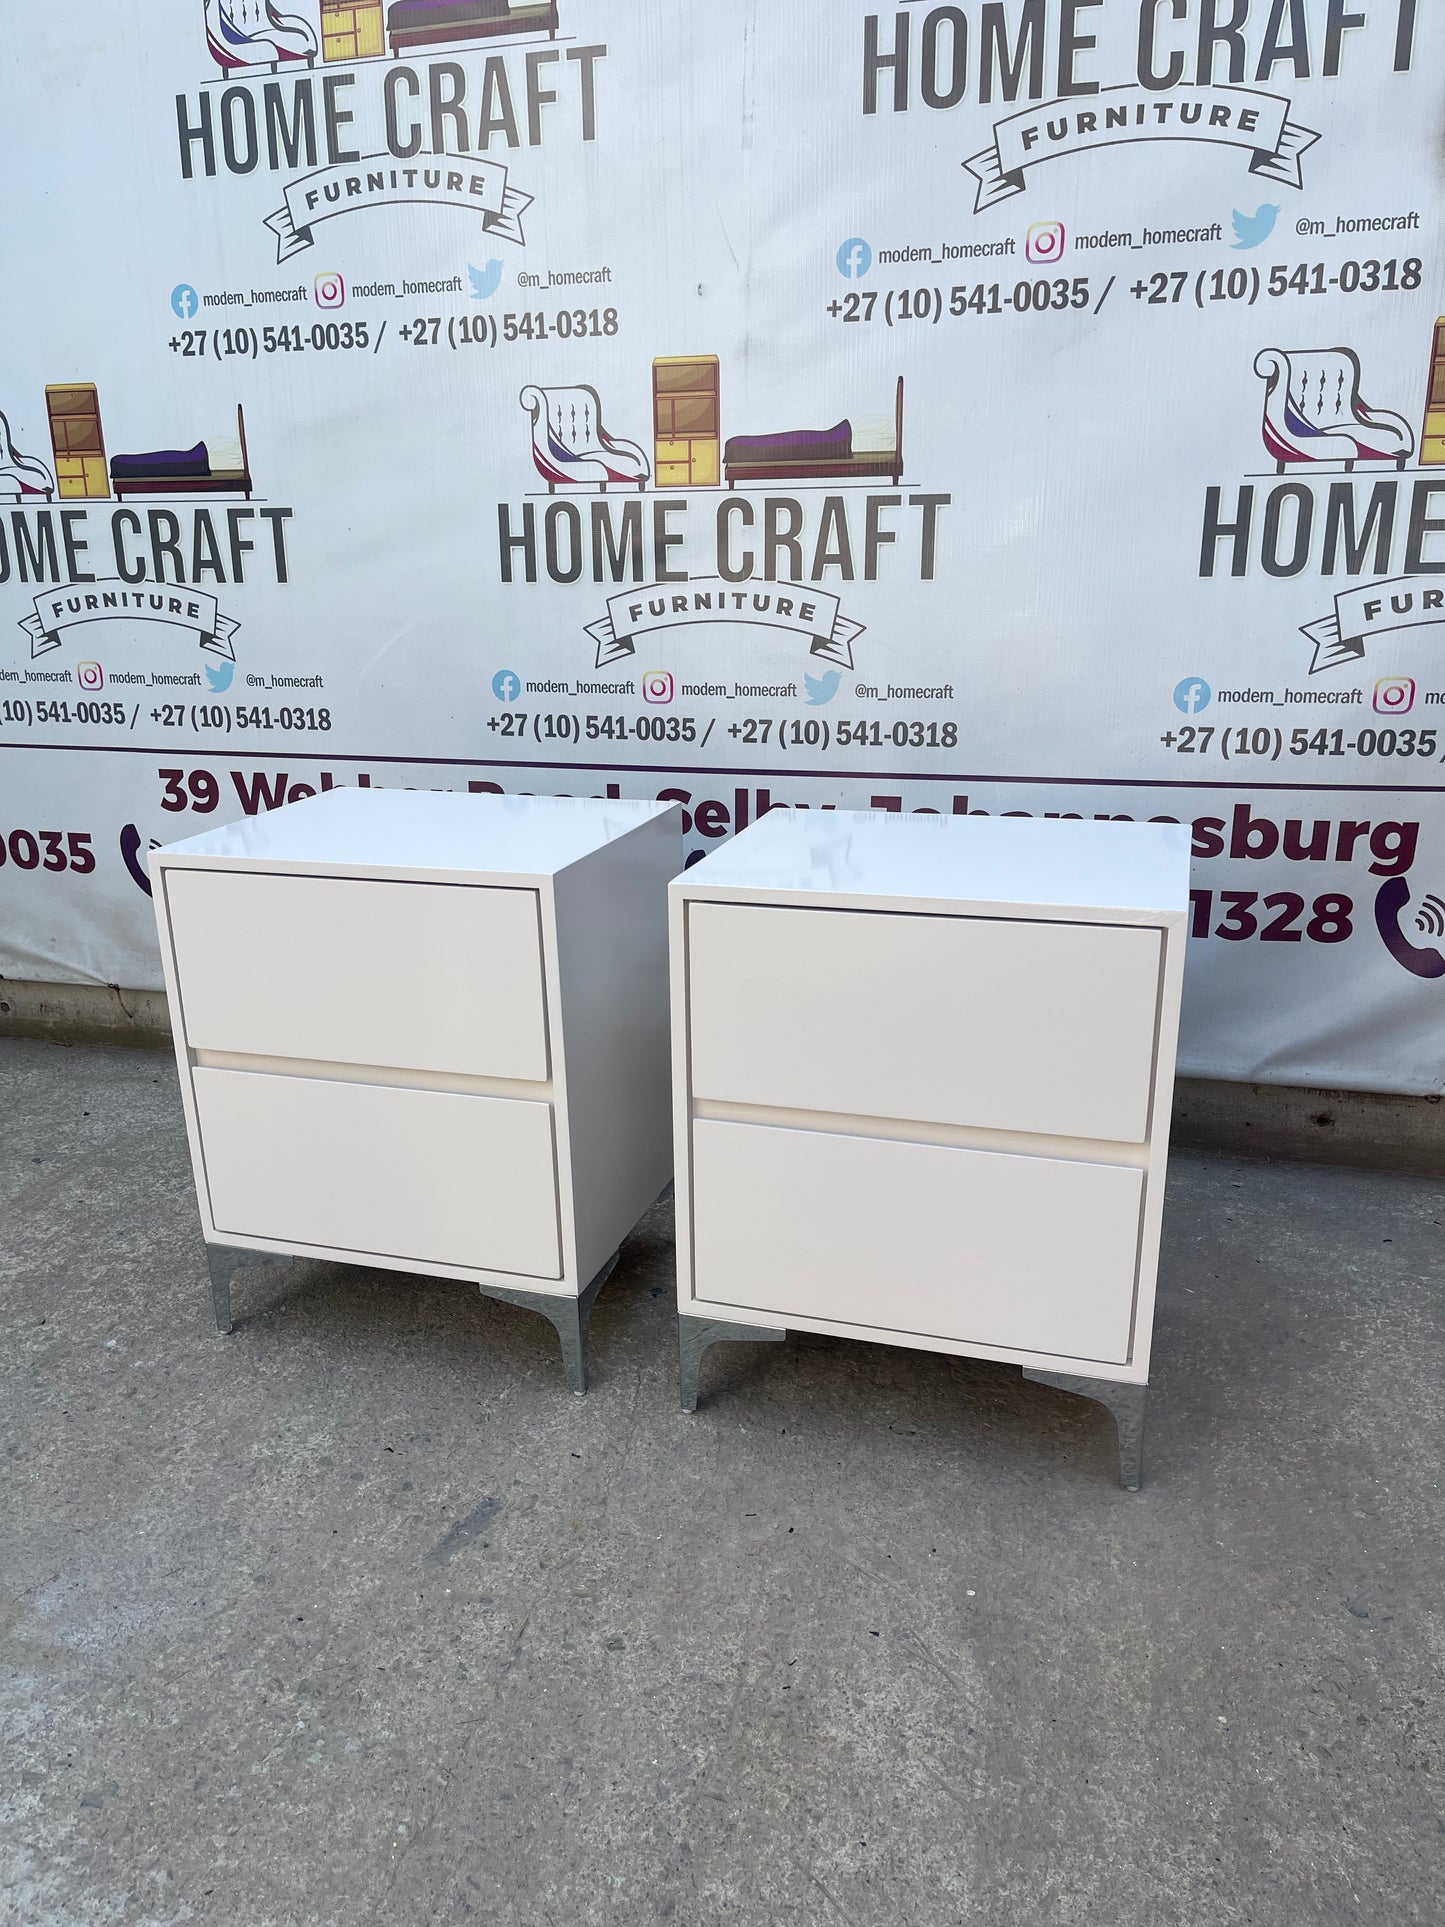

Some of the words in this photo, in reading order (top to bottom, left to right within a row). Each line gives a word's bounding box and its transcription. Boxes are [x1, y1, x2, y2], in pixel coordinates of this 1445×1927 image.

[863, 0, 1101, 115] HOME
[175, 73, 361, 179] HOME
[384, 44, 607, 158] CRAFT
[1021, 102, 1260, 151] FURNITURE
[305, 168, 487, 212] FURNITURE
[1295, 211, 1420, 238] @m_homecraft
[517, 266, 612, 290] @m_homecraft
[826, 292, 878, 323] +27
[884, 287, 943, 327] (10)
[949, 277, 1090, 317] 541-0035
[1129, 271, 1189, 305] +27
[1194, 266, 1260, 309] (10)
[1267, 257, 1423, 297] 541-0318
[168, 330, 207, 357] +27
[213, 327, 258, 361] (10)
[262, 321, 369, 353] 541-0035
[398, 317, 442, 346] +27
[447, 314, 498, 350] (10)
[503, 307, 619, 342] 541-0318
[0, 510, 96, 584] ME
[111, 507, 293, 584] CRAFT
[497, 499, 688, 583] HOME
[716, 493, 951, 583] CRAFT
[1199, 480, 1445, 577] HOME
[52, 592, 200, 619] FURNITURE
[628, 592, 816, 622] FURNITURE
[246, 673, 324, 690] @m_homecraft
[854, 683, 954, 701] @m_homecraft
[36, 700, 126, 725] 541-0035
[150, 704, 186, 727] +27
[190, 705, 232, 733] (10)
[236, 706, 332, 732] 541-0318
[486, 712, 528, 737] +27
[533, 713, 580, 744] (10)
[585, 715, 697, 743] 541-0035
[727, 718, 773, 744] +27
[778, 719, 830, 750] (10)
[835, 720, 958, 748] 541-0318
[1159, 725, 1215, 754] +27
[1221, 727, 1283, 761] (10)
[1289, 728, 1438, 757] 541-0035
[158, 768, 219, 813] 39
[0, 829, 96, 874] 035
